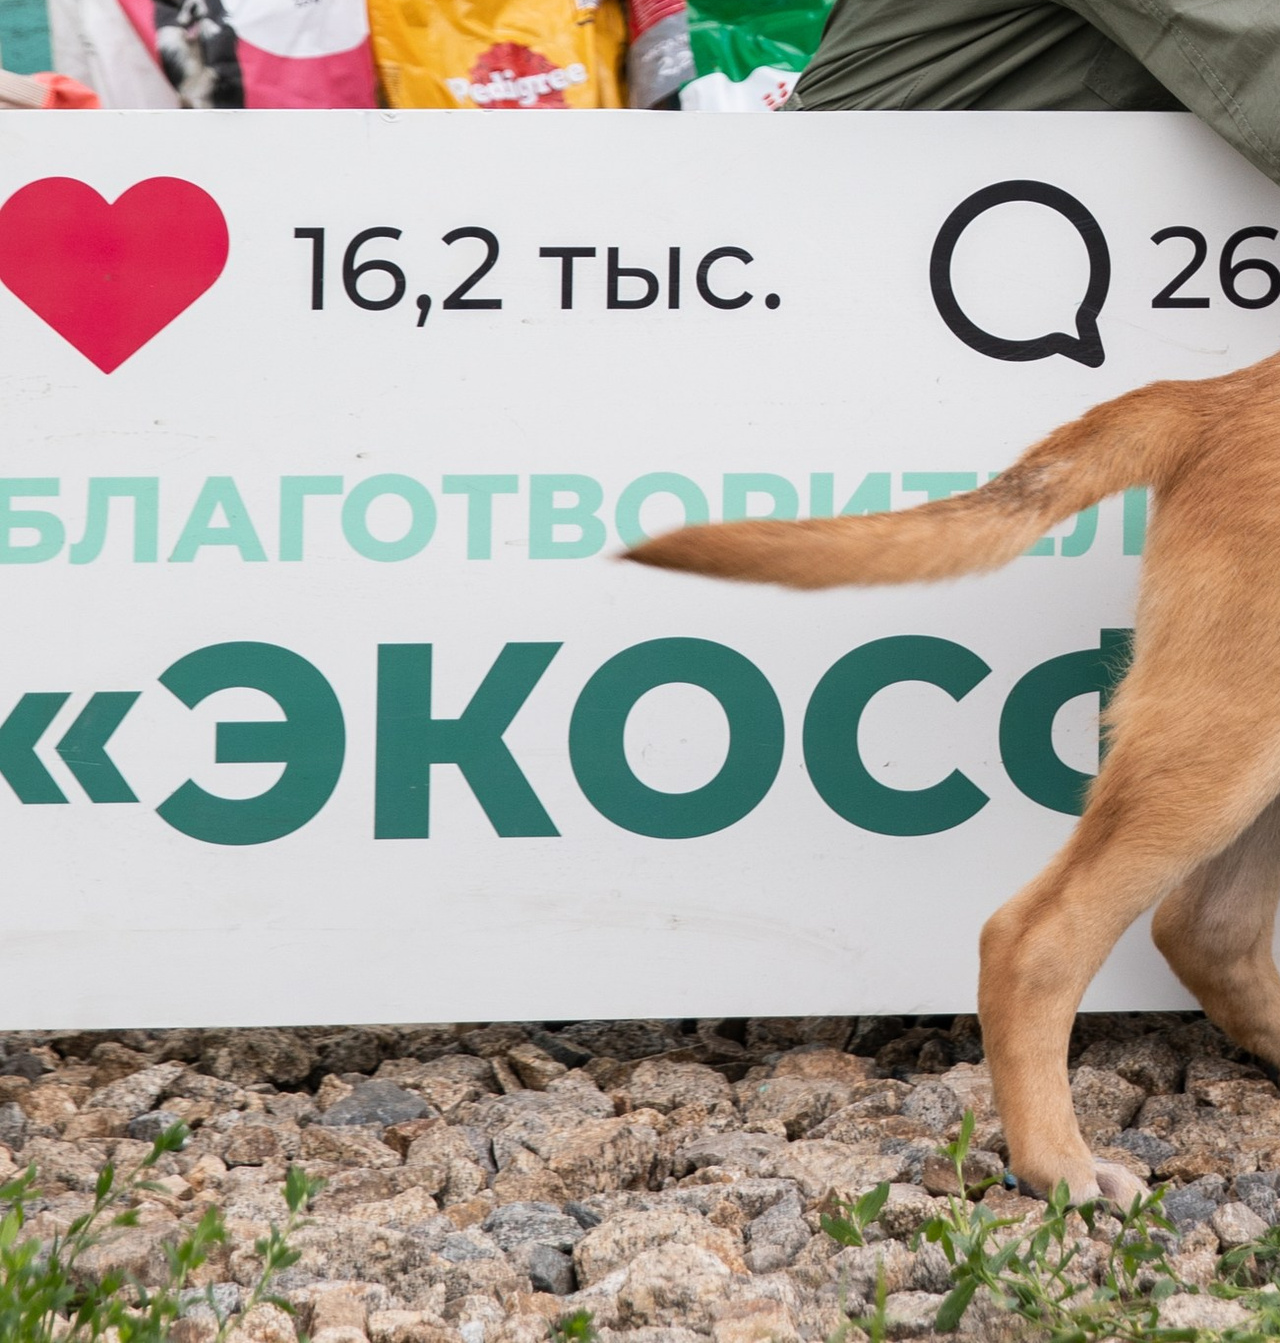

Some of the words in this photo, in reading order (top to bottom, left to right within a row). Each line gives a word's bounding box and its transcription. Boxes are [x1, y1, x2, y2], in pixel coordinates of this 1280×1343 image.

[445, 62, 588, 107] Pedigree
[294, 225, 503, 327] 16,2
[540, 244, 782, 311] тыс.
